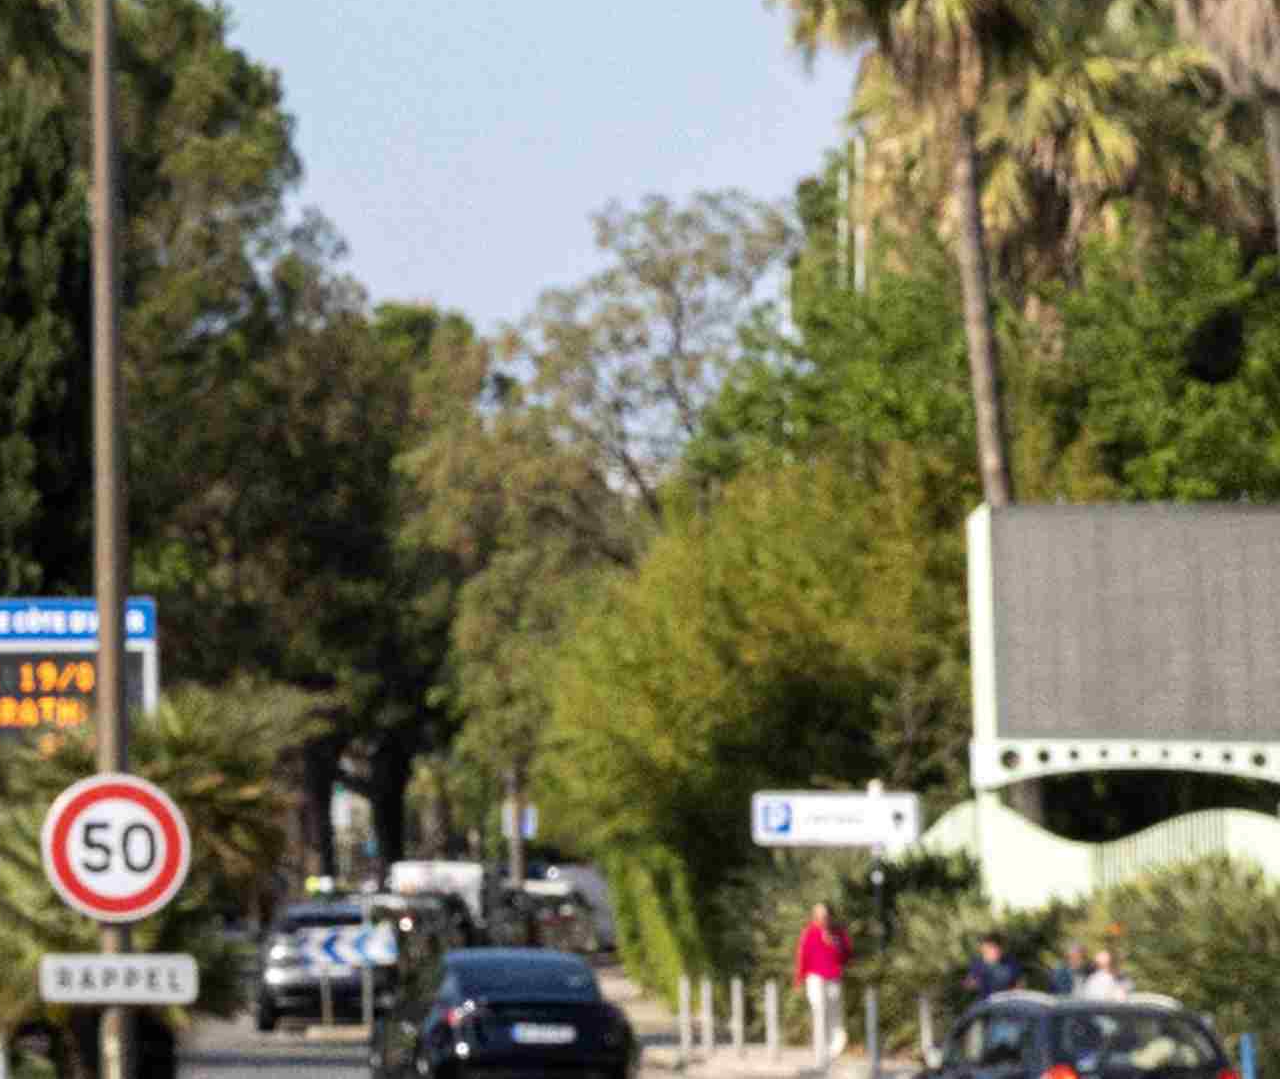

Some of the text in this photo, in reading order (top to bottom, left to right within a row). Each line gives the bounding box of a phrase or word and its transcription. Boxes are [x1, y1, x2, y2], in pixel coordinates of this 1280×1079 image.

[18, 659, 96, 694] 19/0
[82, 822, 157, 874] 50
[56, 967, 182, 992] RAPPEL
